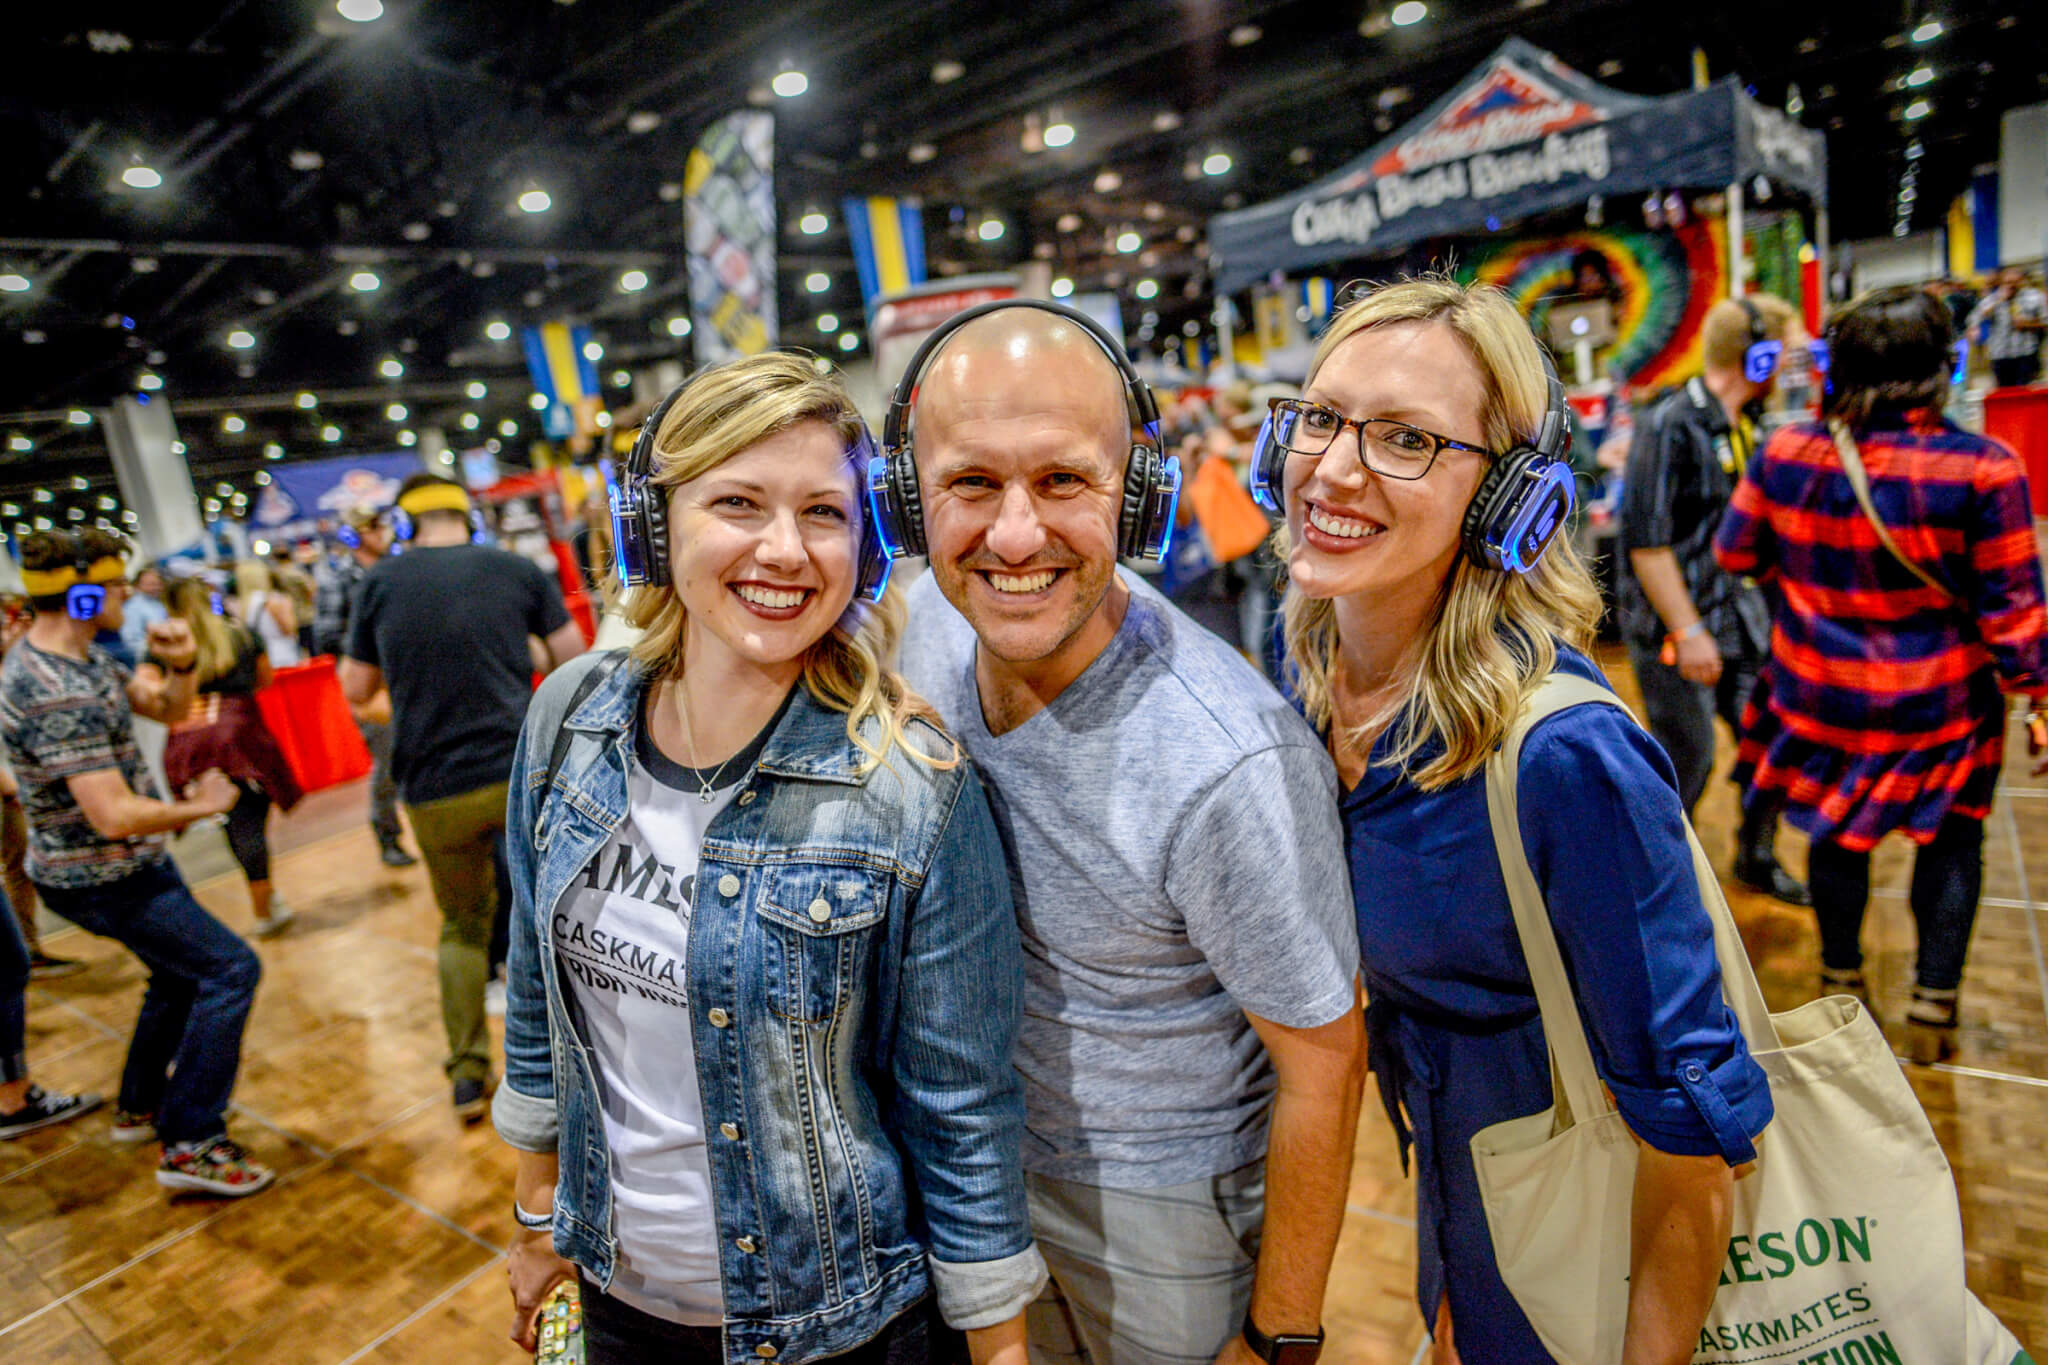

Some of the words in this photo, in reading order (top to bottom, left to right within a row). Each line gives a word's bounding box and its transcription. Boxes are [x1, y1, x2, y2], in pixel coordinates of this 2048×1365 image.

[553, 913, 687, 987] CASKMA
[1718, 1215, 1872, 1286] ESON
[1693, 1286, 1871, 1354] ASKMATES
